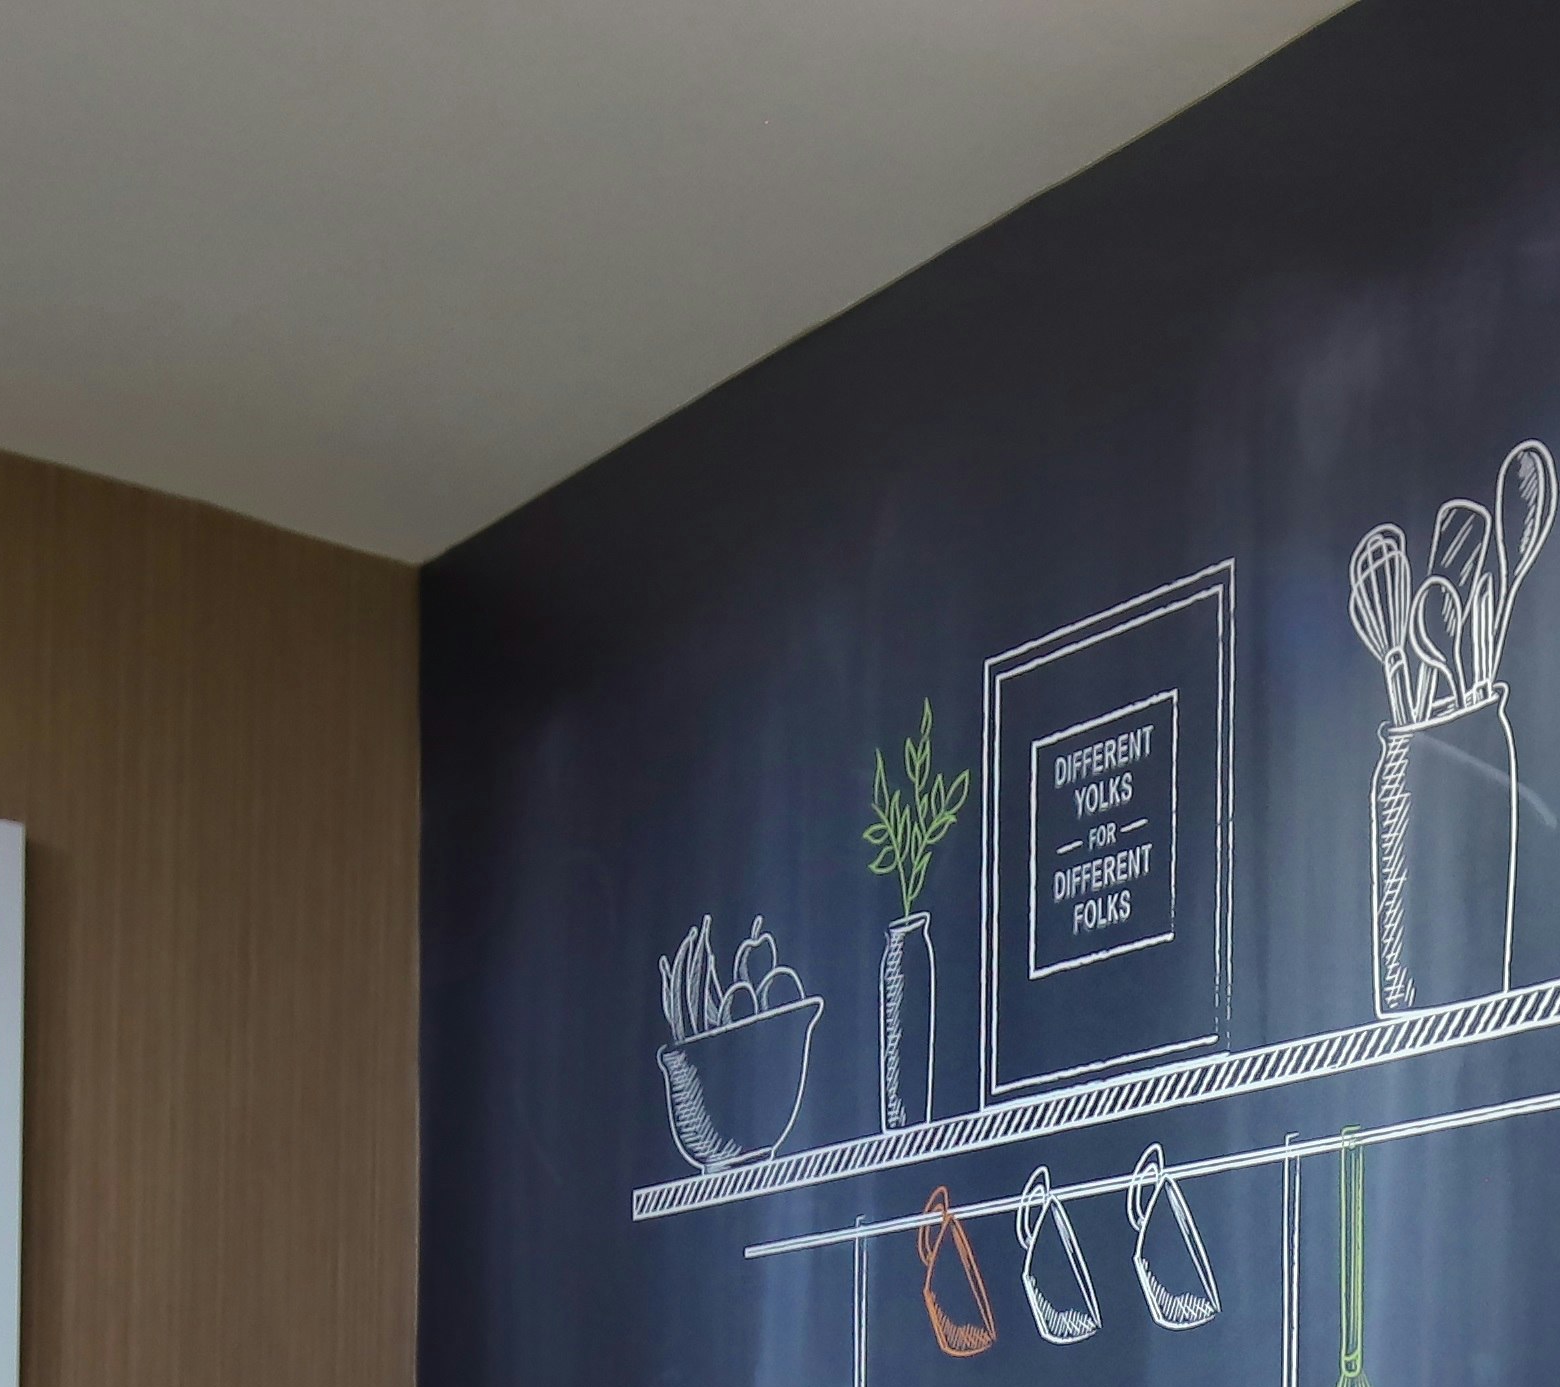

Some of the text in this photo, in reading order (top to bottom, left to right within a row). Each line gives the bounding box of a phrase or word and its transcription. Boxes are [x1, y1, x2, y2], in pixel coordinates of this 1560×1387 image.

[1054, 725, 1153, 787] DIFFERENT
[1073, 775, 1133, 819] YOLKS
[1088, 822, 1117, 851] FOR
[1053, 843, 1153, 903] DIFFERENT
[1073, 890, 1132, 934] FOLKS
